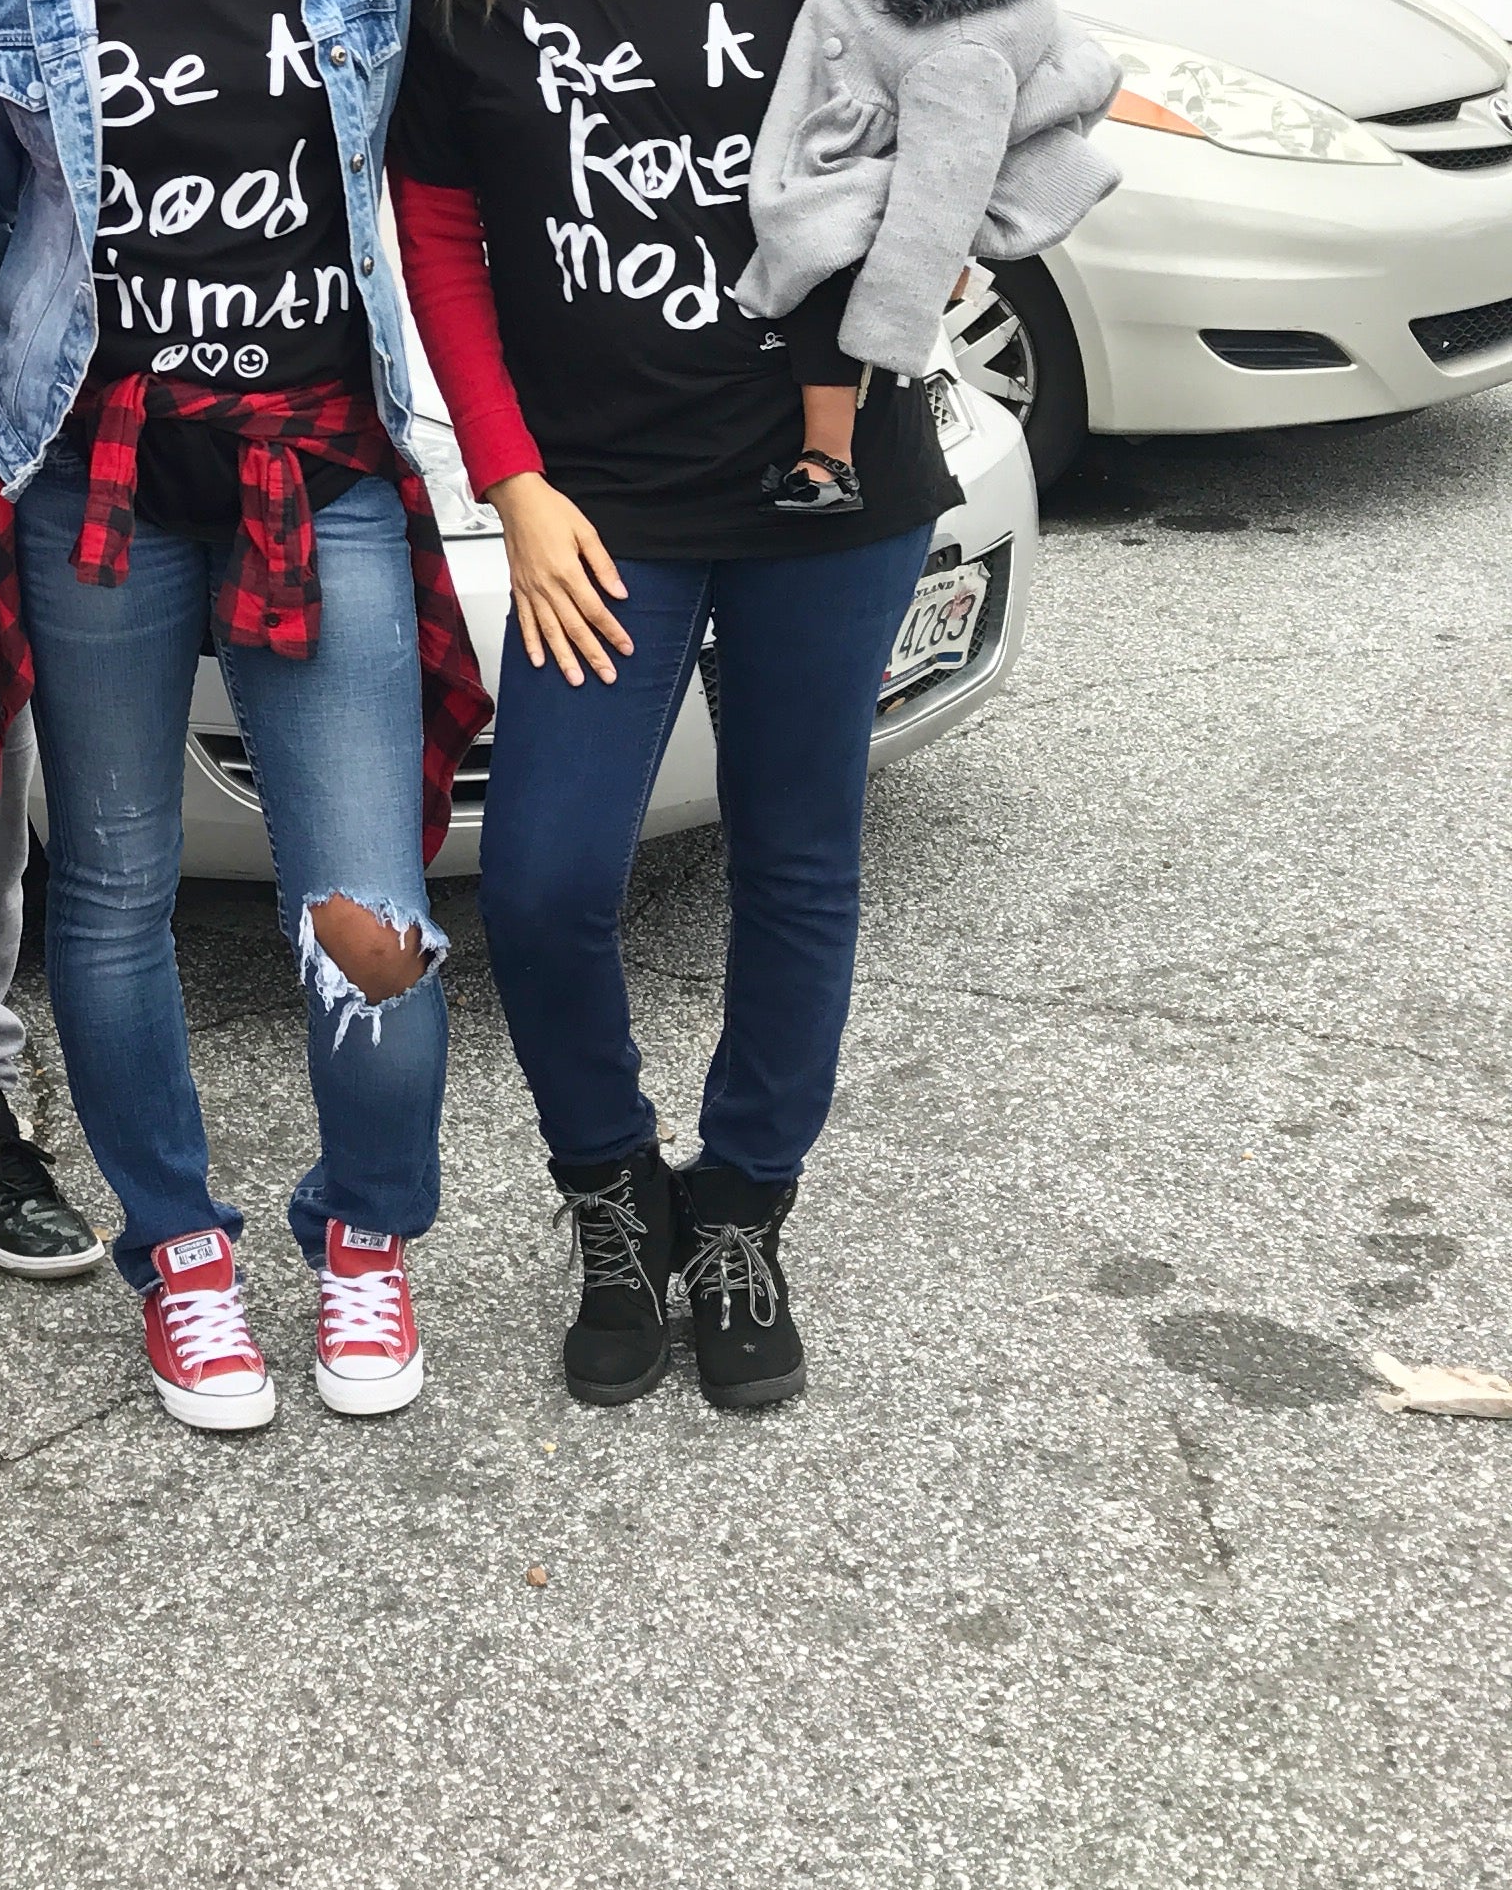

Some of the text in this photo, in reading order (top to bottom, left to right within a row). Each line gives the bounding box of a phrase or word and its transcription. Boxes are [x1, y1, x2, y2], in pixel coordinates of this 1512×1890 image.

[95, 40, 219, 127] Be
[523, 2, 765, 114] Be A
